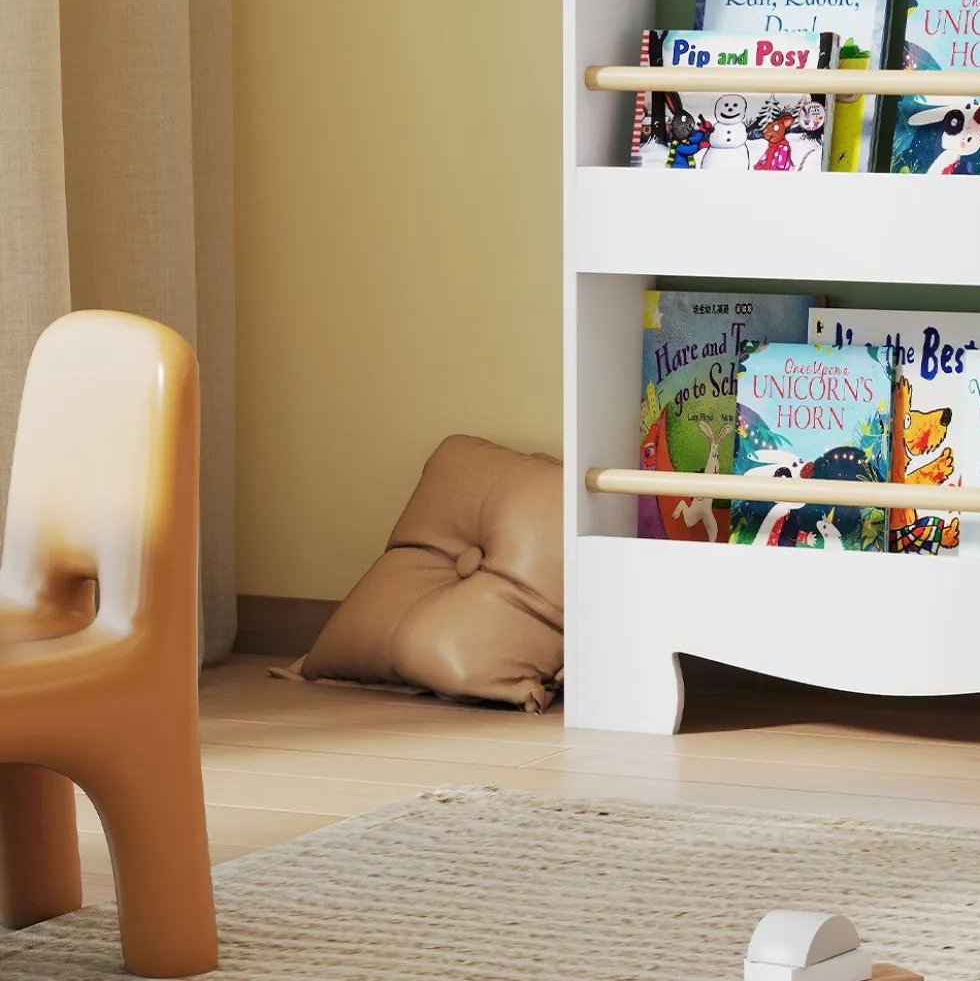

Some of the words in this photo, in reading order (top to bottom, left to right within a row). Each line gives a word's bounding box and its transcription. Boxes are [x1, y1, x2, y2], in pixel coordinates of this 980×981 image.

[672, 39, 710, 68] Pip
[717, 49, 748, 65] and
[755, 40, 810, 69] Posy
[654, 341, 698, 385] Hare
[702, 332, 727, 358] and
[883, 332, 915, 366] the
[784, 358, 811, 375] Once
[811, 360, 841, 381] Upon
[843, 365, 851, 376] a
[674, 387, 690, 417] go
[692, 378, 706, 399] to
[709, 362, 738, 398] Sch
[752, 374, 875, 403] UNICORN'S
[776, 405, 845, 431] HORN
